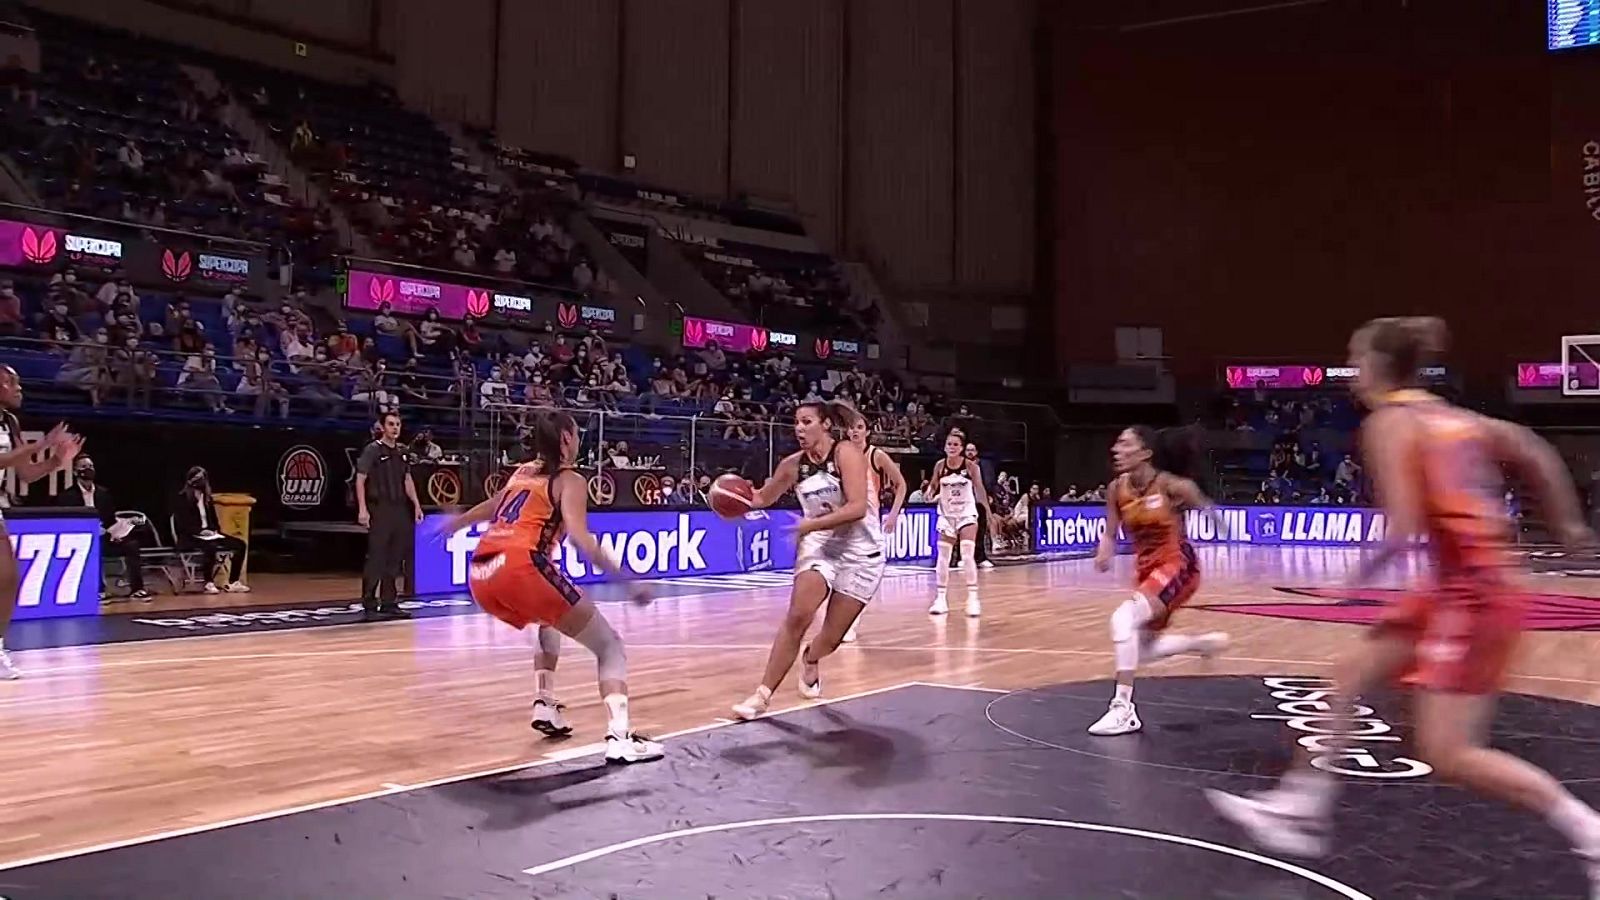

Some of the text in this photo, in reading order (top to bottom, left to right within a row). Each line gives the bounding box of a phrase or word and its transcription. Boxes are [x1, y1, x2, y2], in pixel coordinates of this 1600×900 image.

[286, 479, 320, 494] UNI
[494, 489, 531, 524] 14
[1280, 512, 1363, 542] LLAMA
